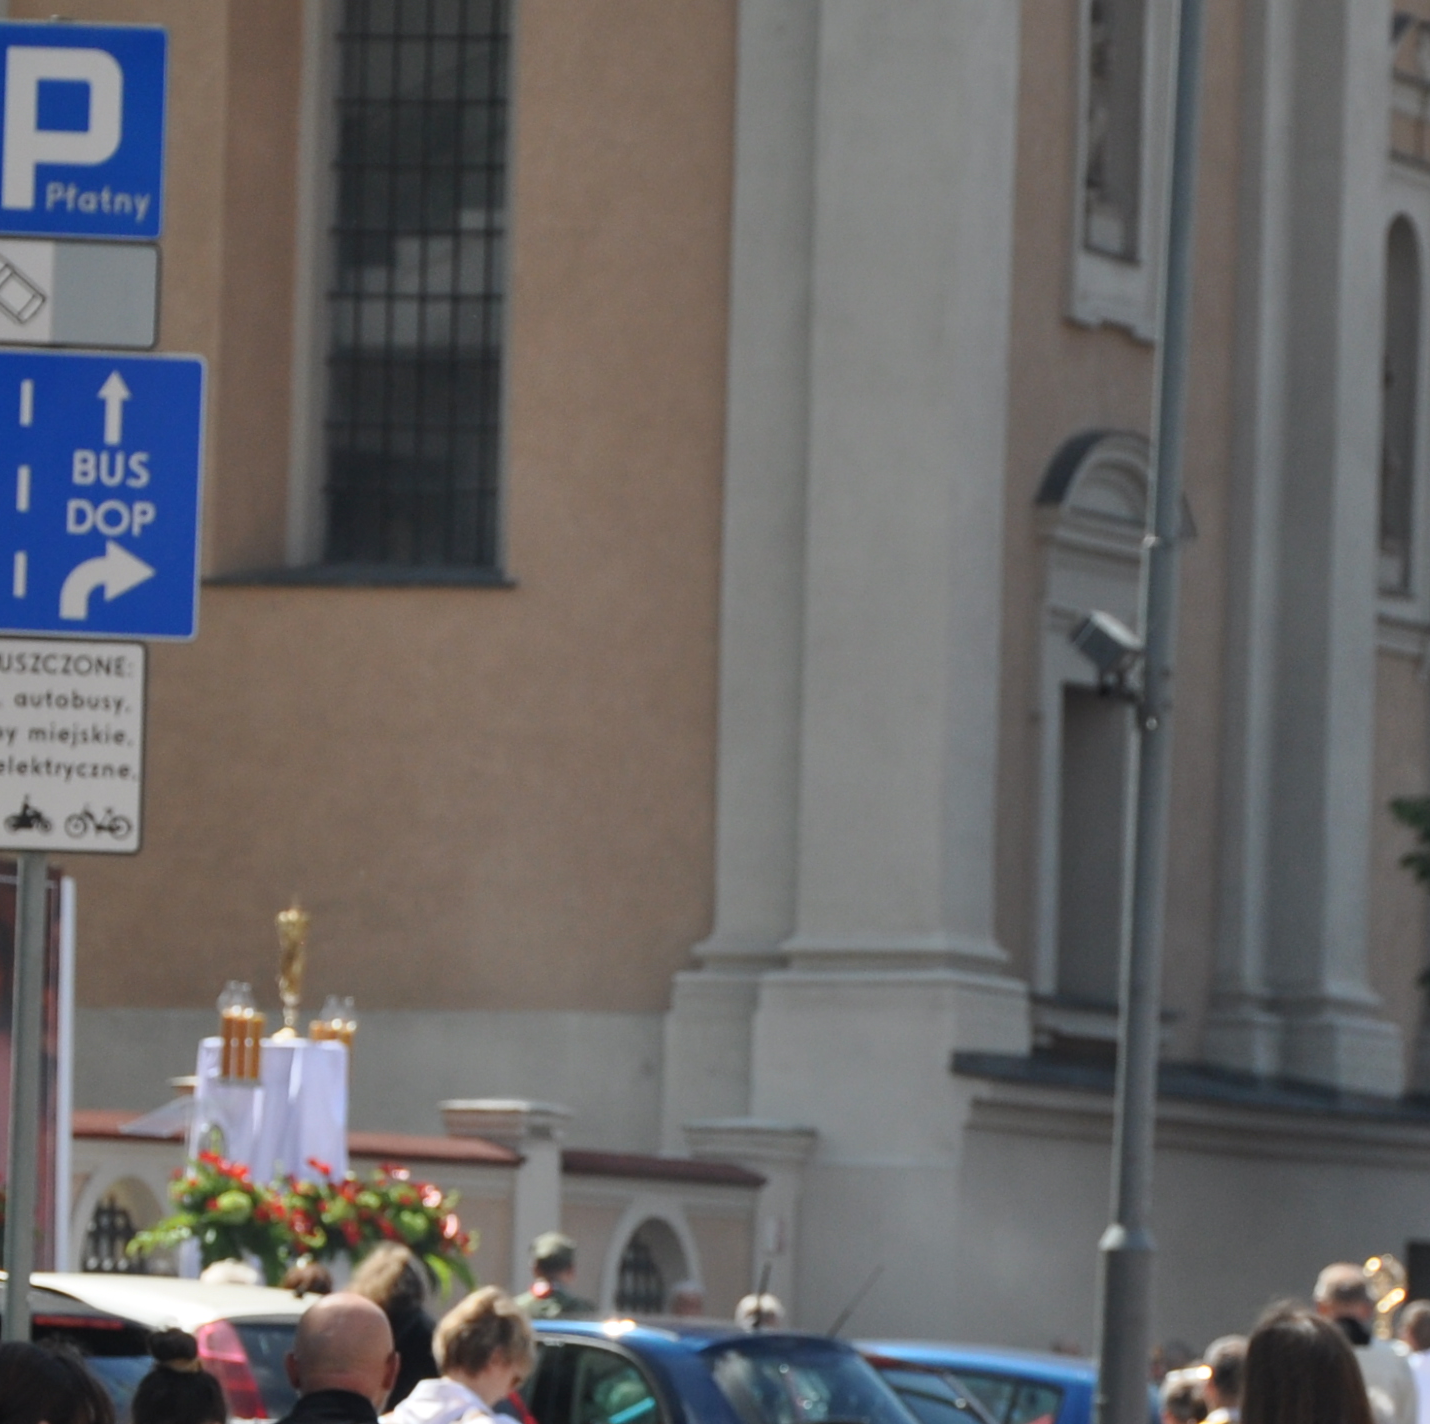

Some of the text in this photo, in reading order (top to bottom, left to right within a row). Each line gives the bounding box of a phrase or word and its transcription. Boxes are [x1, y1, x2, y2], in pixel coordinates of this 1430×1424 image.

[1, 45, 123, 210] P
[45, 181, 151, 223] Płatny
[72, 449, 151, 489] BUS
[66, 498, 157, 537] DOP
